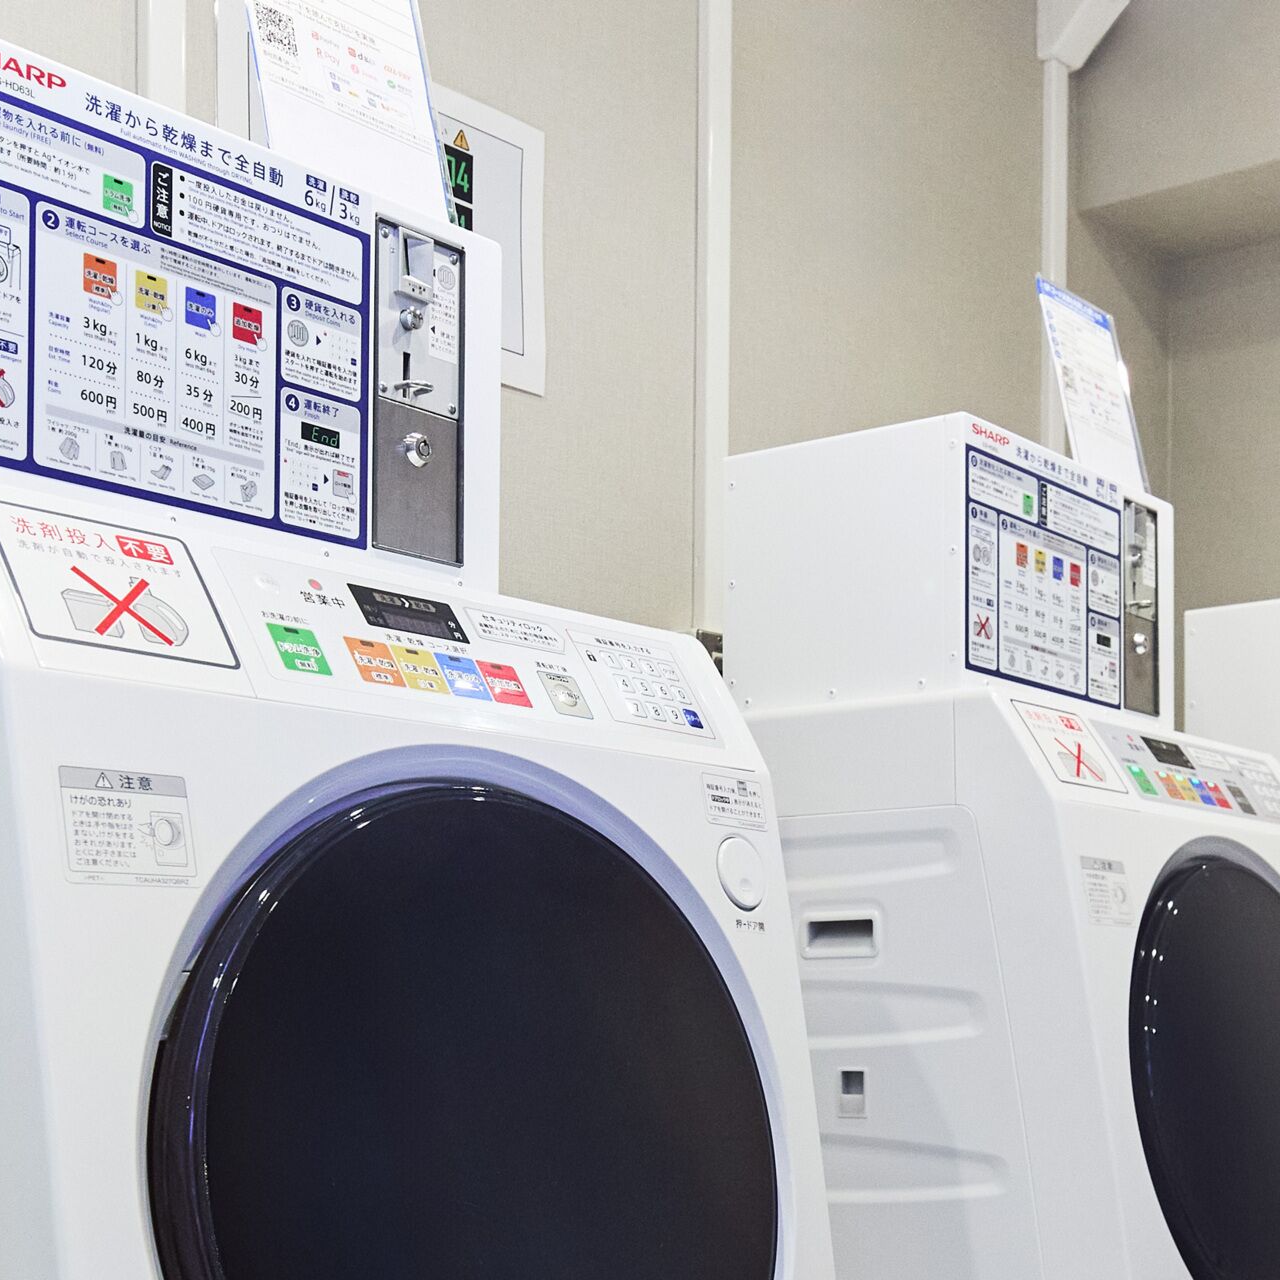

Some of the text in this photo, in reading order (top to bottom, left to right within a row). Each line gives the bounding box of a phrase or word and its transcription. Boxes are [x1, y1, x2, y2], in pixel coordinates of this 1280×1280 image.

[85, 91, 284, 188] 洗濯から乾燥まで全自動
[155, 168, 168, 220] ご注意
[9, 208, 24, 221] Start
[65, 215, 151, 256] 運転コースを選ぶ
[153, 219, 171, 233] NOTICE
[65, 228, 107, 249] Select Course
[304, 298, 355, 325] 硬貨を入れる
[303, 398, 339, 418] 運転終了
[123, 425, 197, 452] 洗濯量の目安 Reference
[311, 426, 338, 447] End
[972, 423, 1010, 447] SHARP
[10, 515, 170, 561] 洗剤投入 不要
[300, 590, 345, 609] 営業中
[119, 774, 153, 791] 注意
[70, 795, 132, 808] けがの恐れあり
